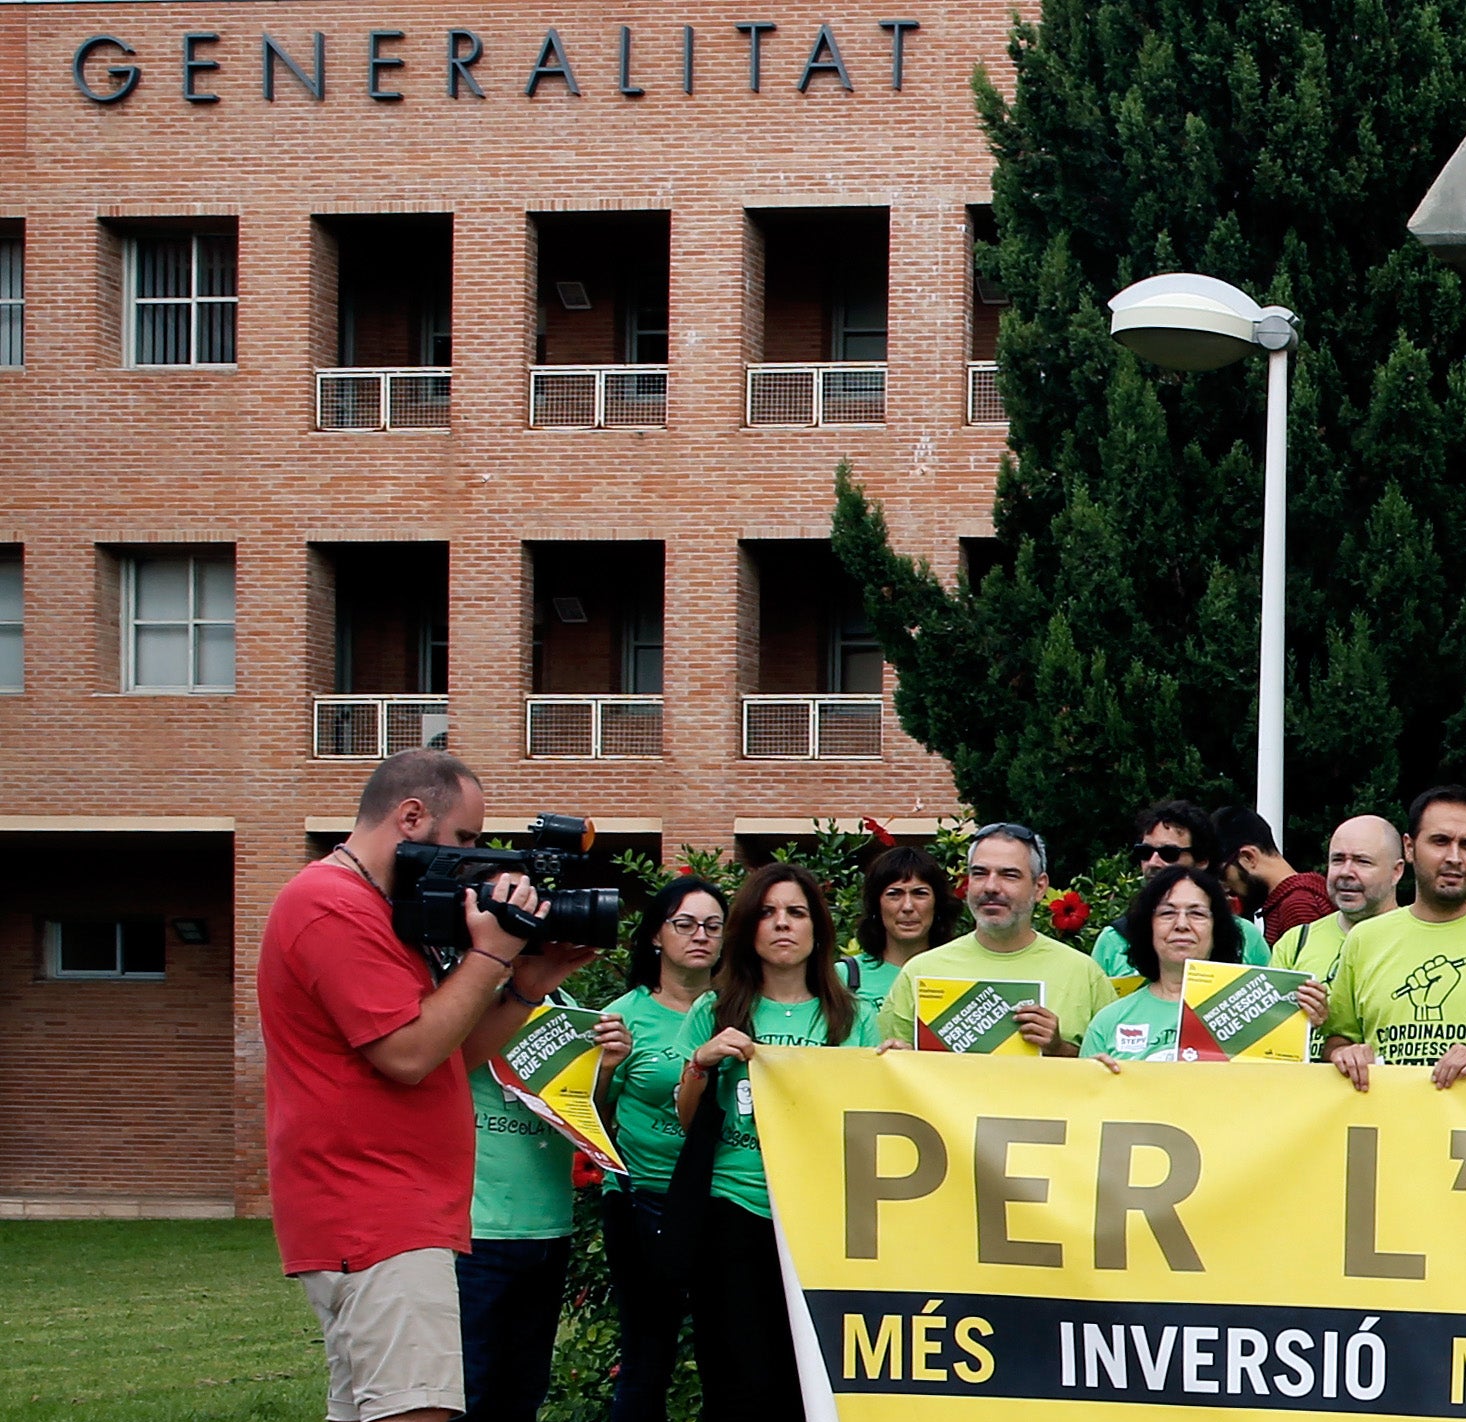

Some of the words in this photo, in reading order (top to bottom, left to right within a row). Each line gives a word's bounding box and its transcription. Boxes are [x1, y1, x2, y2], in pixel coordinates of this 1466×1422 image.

[73, 21, 921, 104] GENERALITAT
[944, 1027, 965, 1045] PER
[961, 994, 1002, 1030] L'ESCOLA
[952, 1030, 978, 1053] QUE
[973, 1001, 1011, 1035] VOLEM
[1209, 1012, 1230, 1031] PER
[1228, 982, 1274, 1017] L'ESCOLA
[1216, 1018, 1244, 1041] QUE
[1240, 990, 1282, 1023] VOLEM
[511, 1052, 530, 1070] PER
[527, 1021, 573, 1055] L'ESCOLA
[519, 1056, 541, 1080] QUE
[538, 1028, 578, 1060] VOLEM
[843, 1110, 1206, 1273] PER
[842, 1300, 996, 1384] MÉS
[1060, 1317, 1387, 1401] INVERSIÓ
